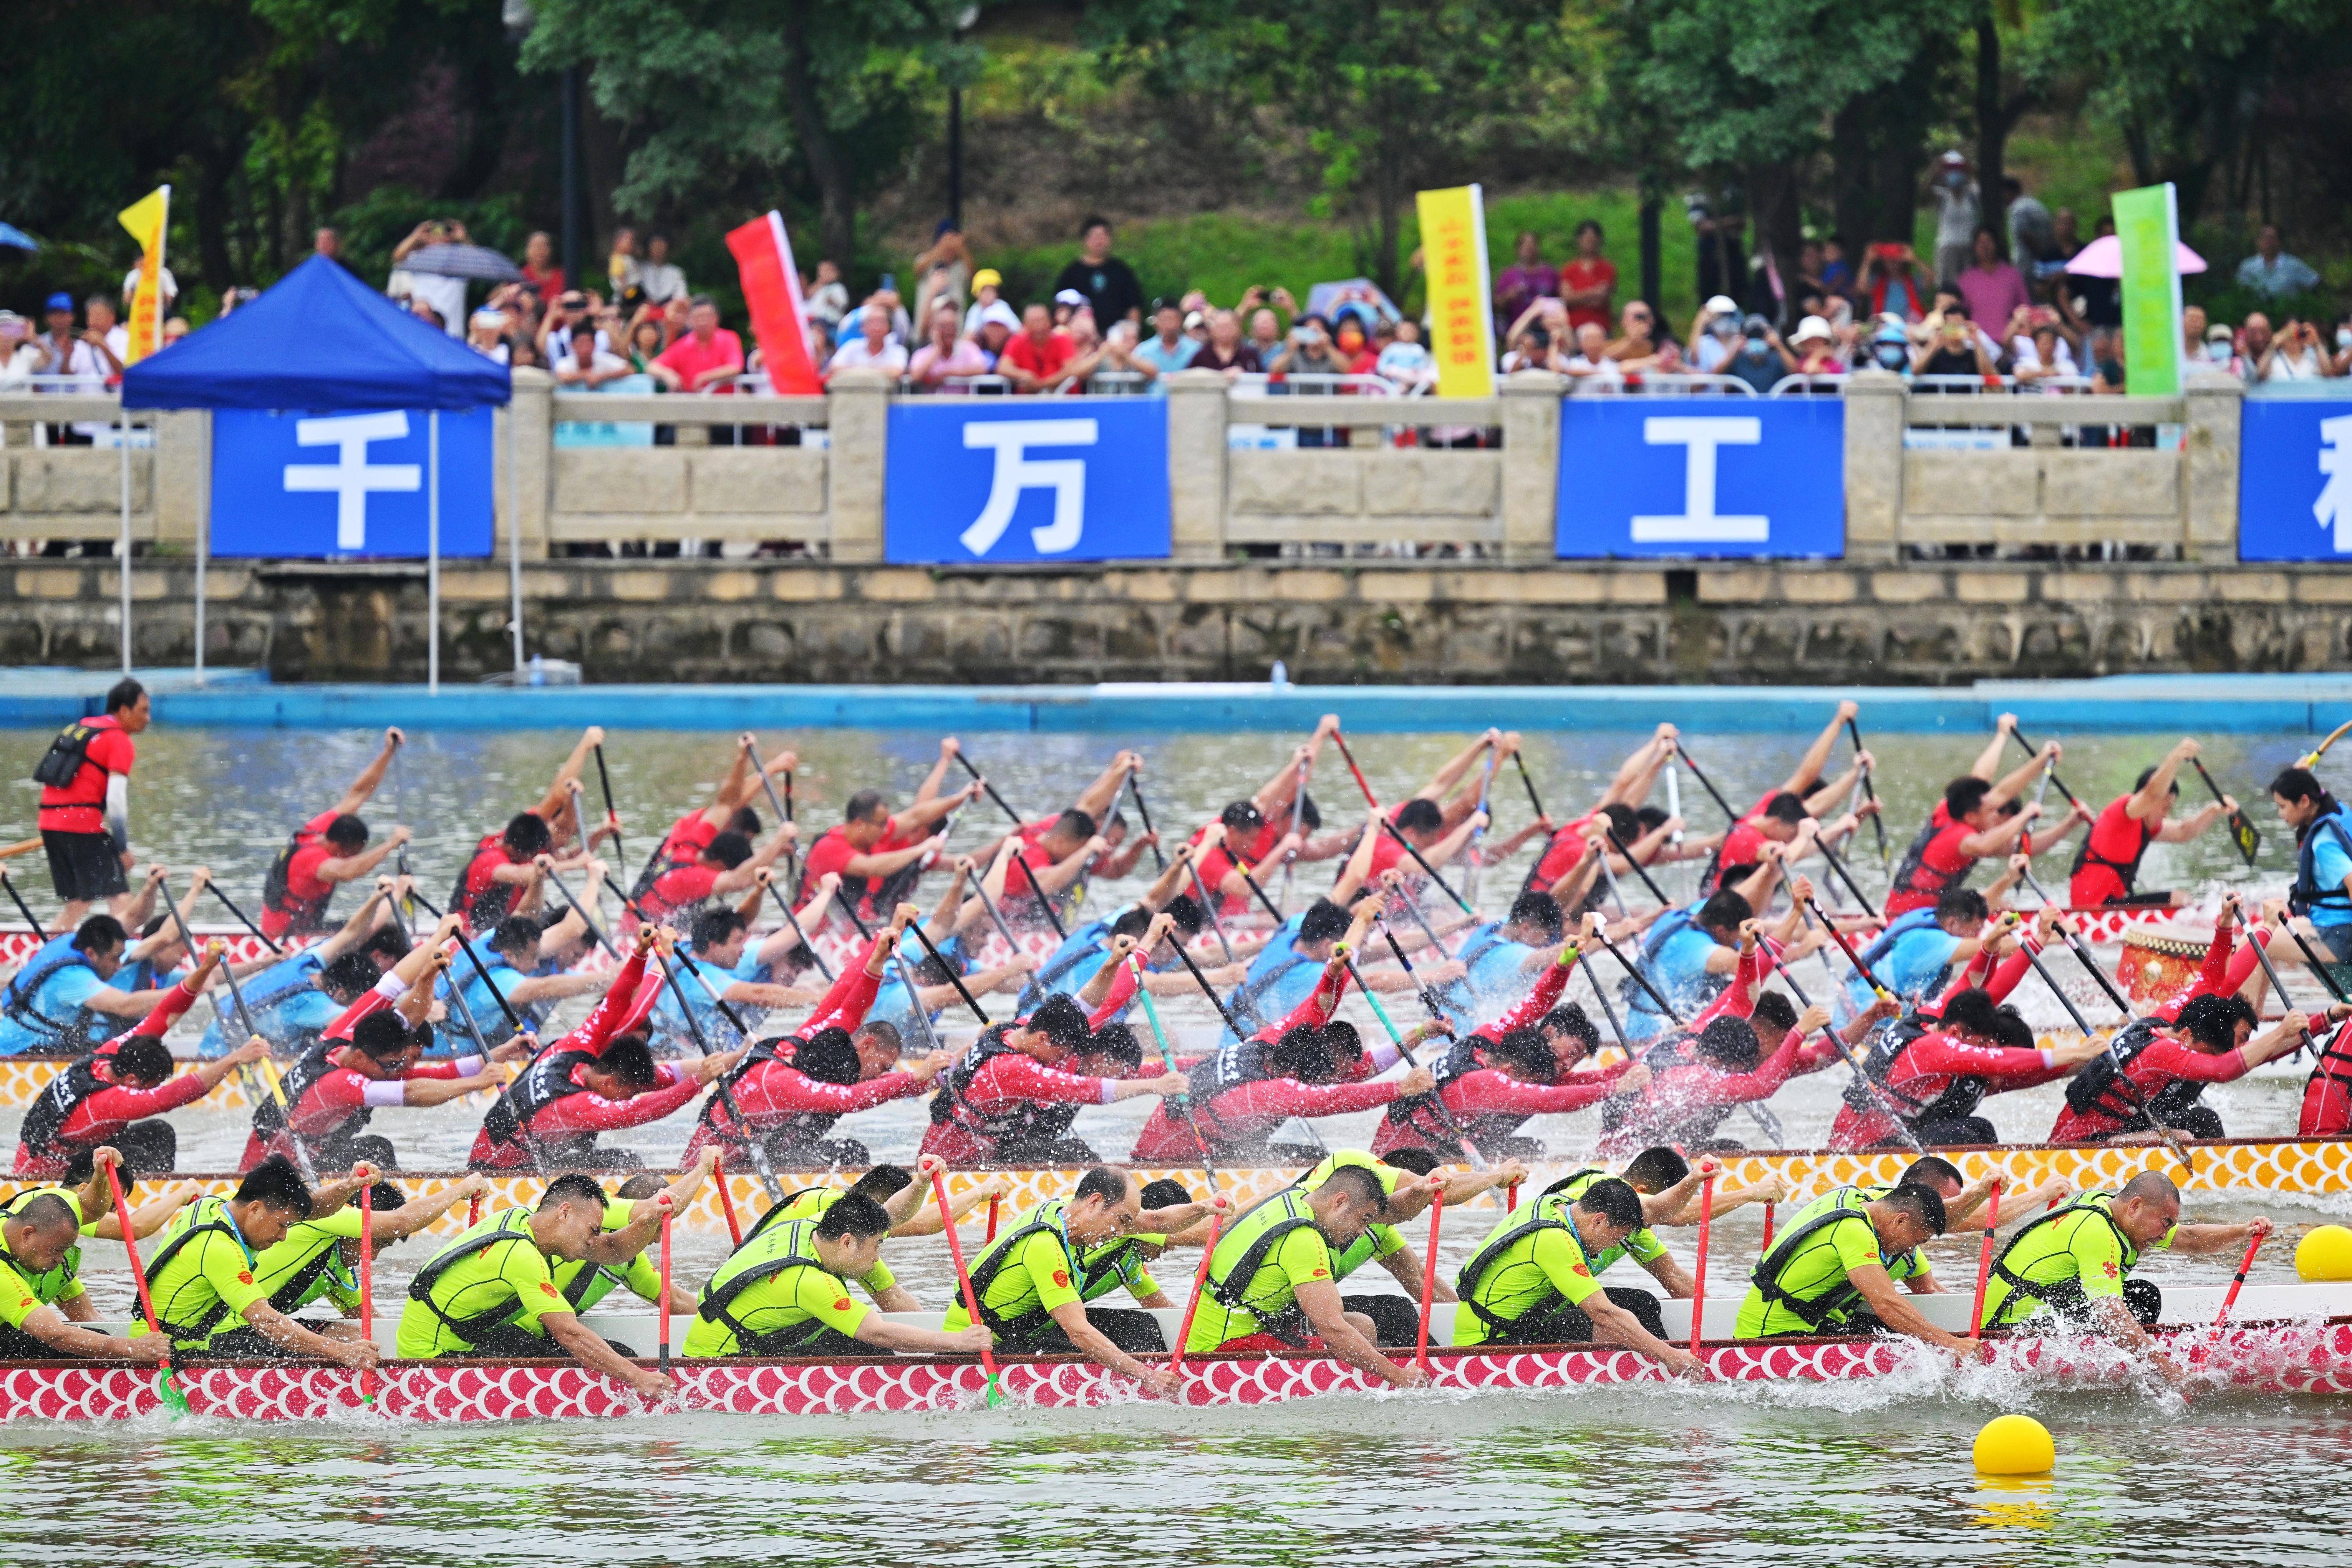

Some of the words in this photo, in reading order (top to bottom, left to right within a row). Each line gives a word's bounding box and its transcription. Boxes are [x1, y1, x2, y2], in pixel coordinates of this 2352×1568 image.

[283, 410, 421, 549] 千
[958, 418, 1099, 557] 万
[1629, 416, 1769, 542] 工
